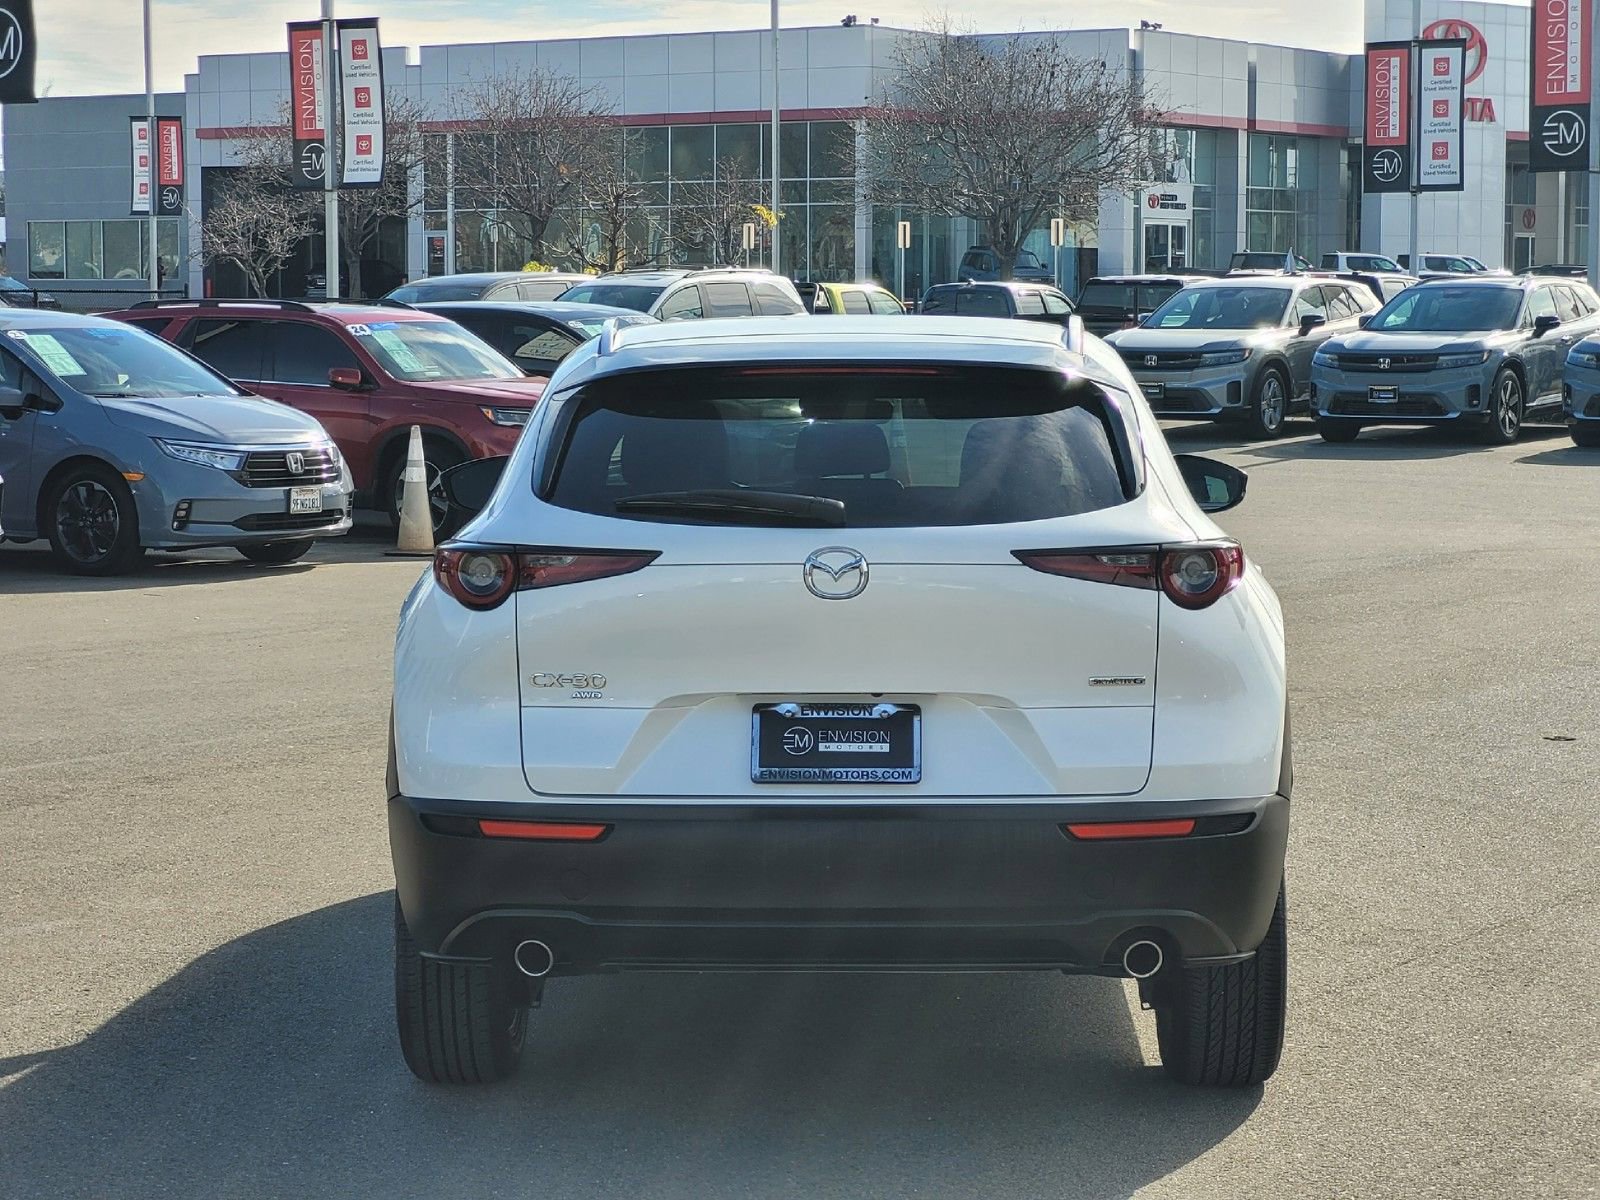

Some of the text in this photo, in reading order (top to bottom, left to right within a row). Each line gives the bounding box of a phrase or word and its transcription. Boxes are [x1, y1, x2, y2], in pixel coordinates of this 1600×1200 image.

[1546, 0, 1567, 95] ENVISIO
[1570, 5, 1579, 83] MOTOR
[298, 38, 316, 131] ENVISION
[1375, 57, 1390, 138] ENVISION
[1391, 64, 1399, 131] MOTORS
[163, 126, 172, 180] ENVISION
[351, 325, 367, 333] 24
[529, 672, 607, 689] CX-30
[572, 690, 602, 699] AWD
[800, 704, 874, 717] ENVISION
[818, 730, 891, 743] ENVISION
[759, 770, 913, 780] ENVISIONMOTORS.COM
